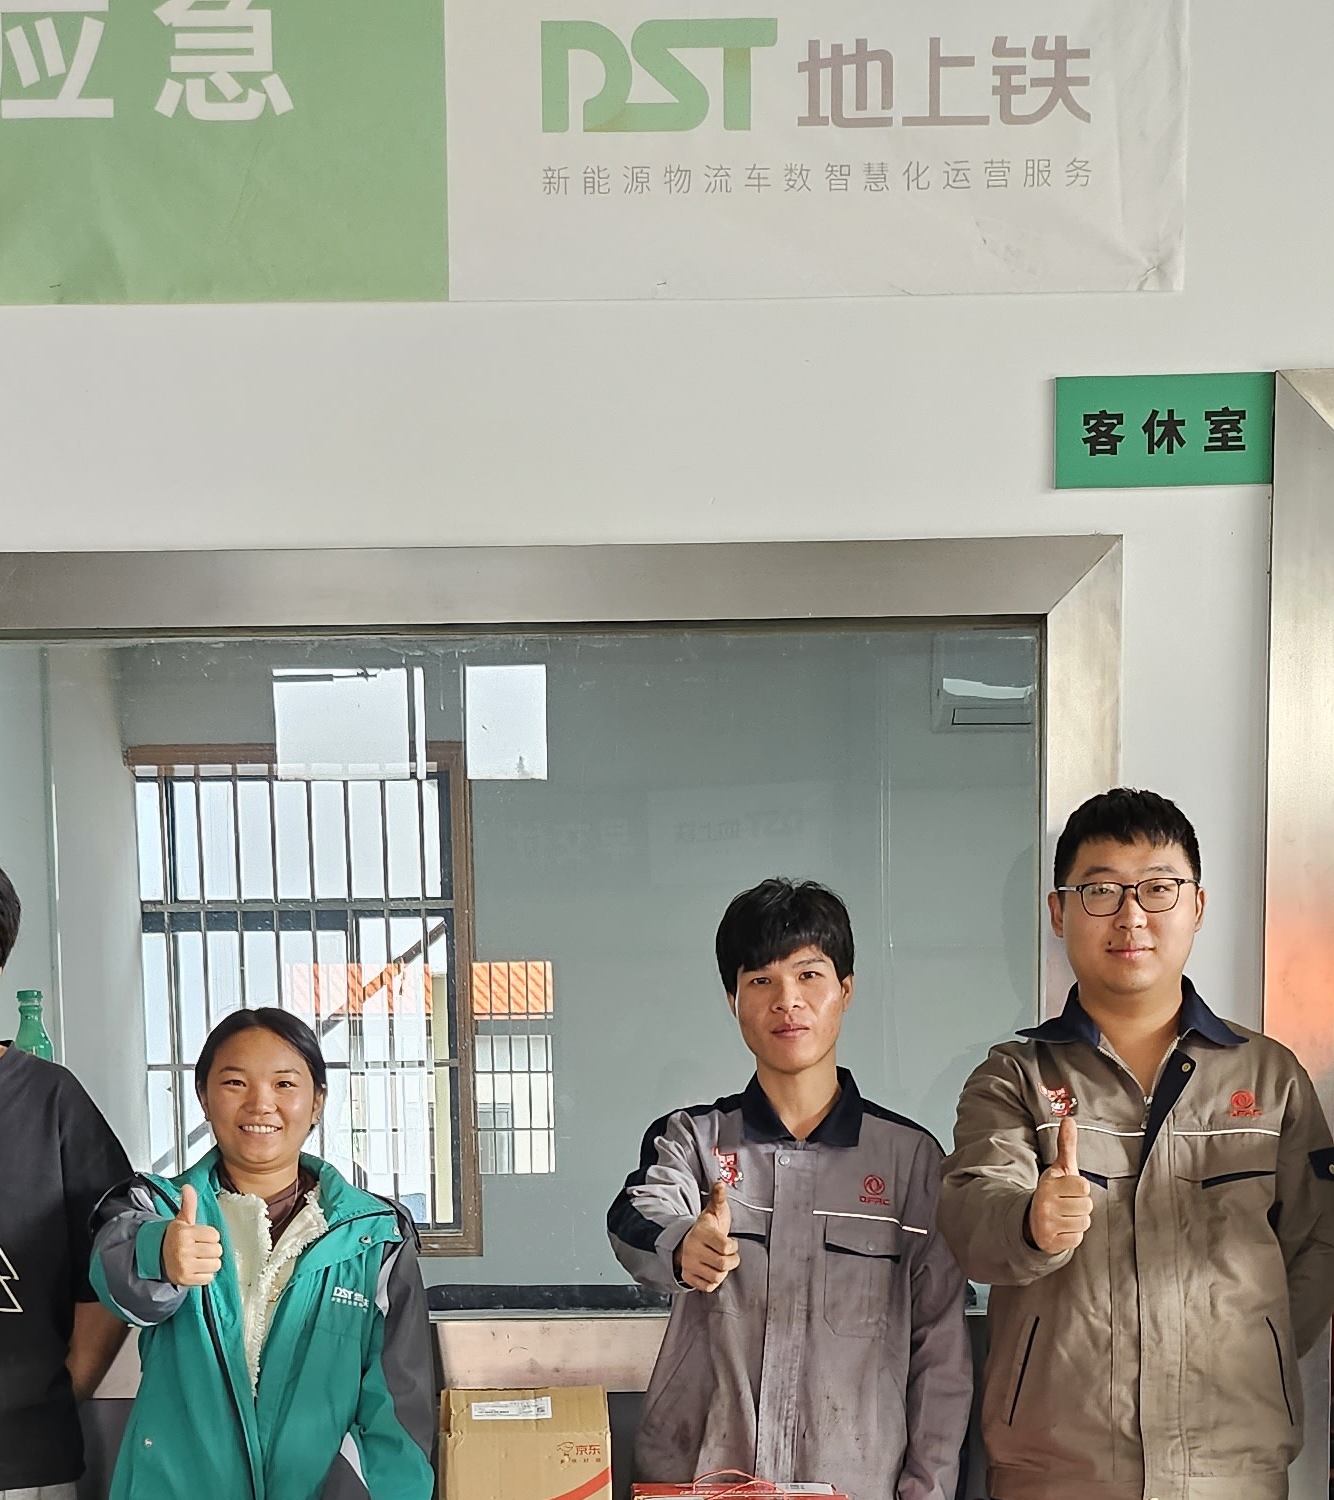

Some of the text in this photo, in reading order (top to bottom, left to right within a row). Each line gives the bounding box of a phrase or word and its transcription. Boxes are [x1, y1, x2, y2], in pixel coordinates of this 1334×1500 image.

[540, 17, 1093, 134] DST 地上铁
[540, 156, 1095, 196] 新能源物流车数智慧化运营服务
[1081, 406, 1248, 457] 客休室
[575, 1444, 602, 1456] 京东
